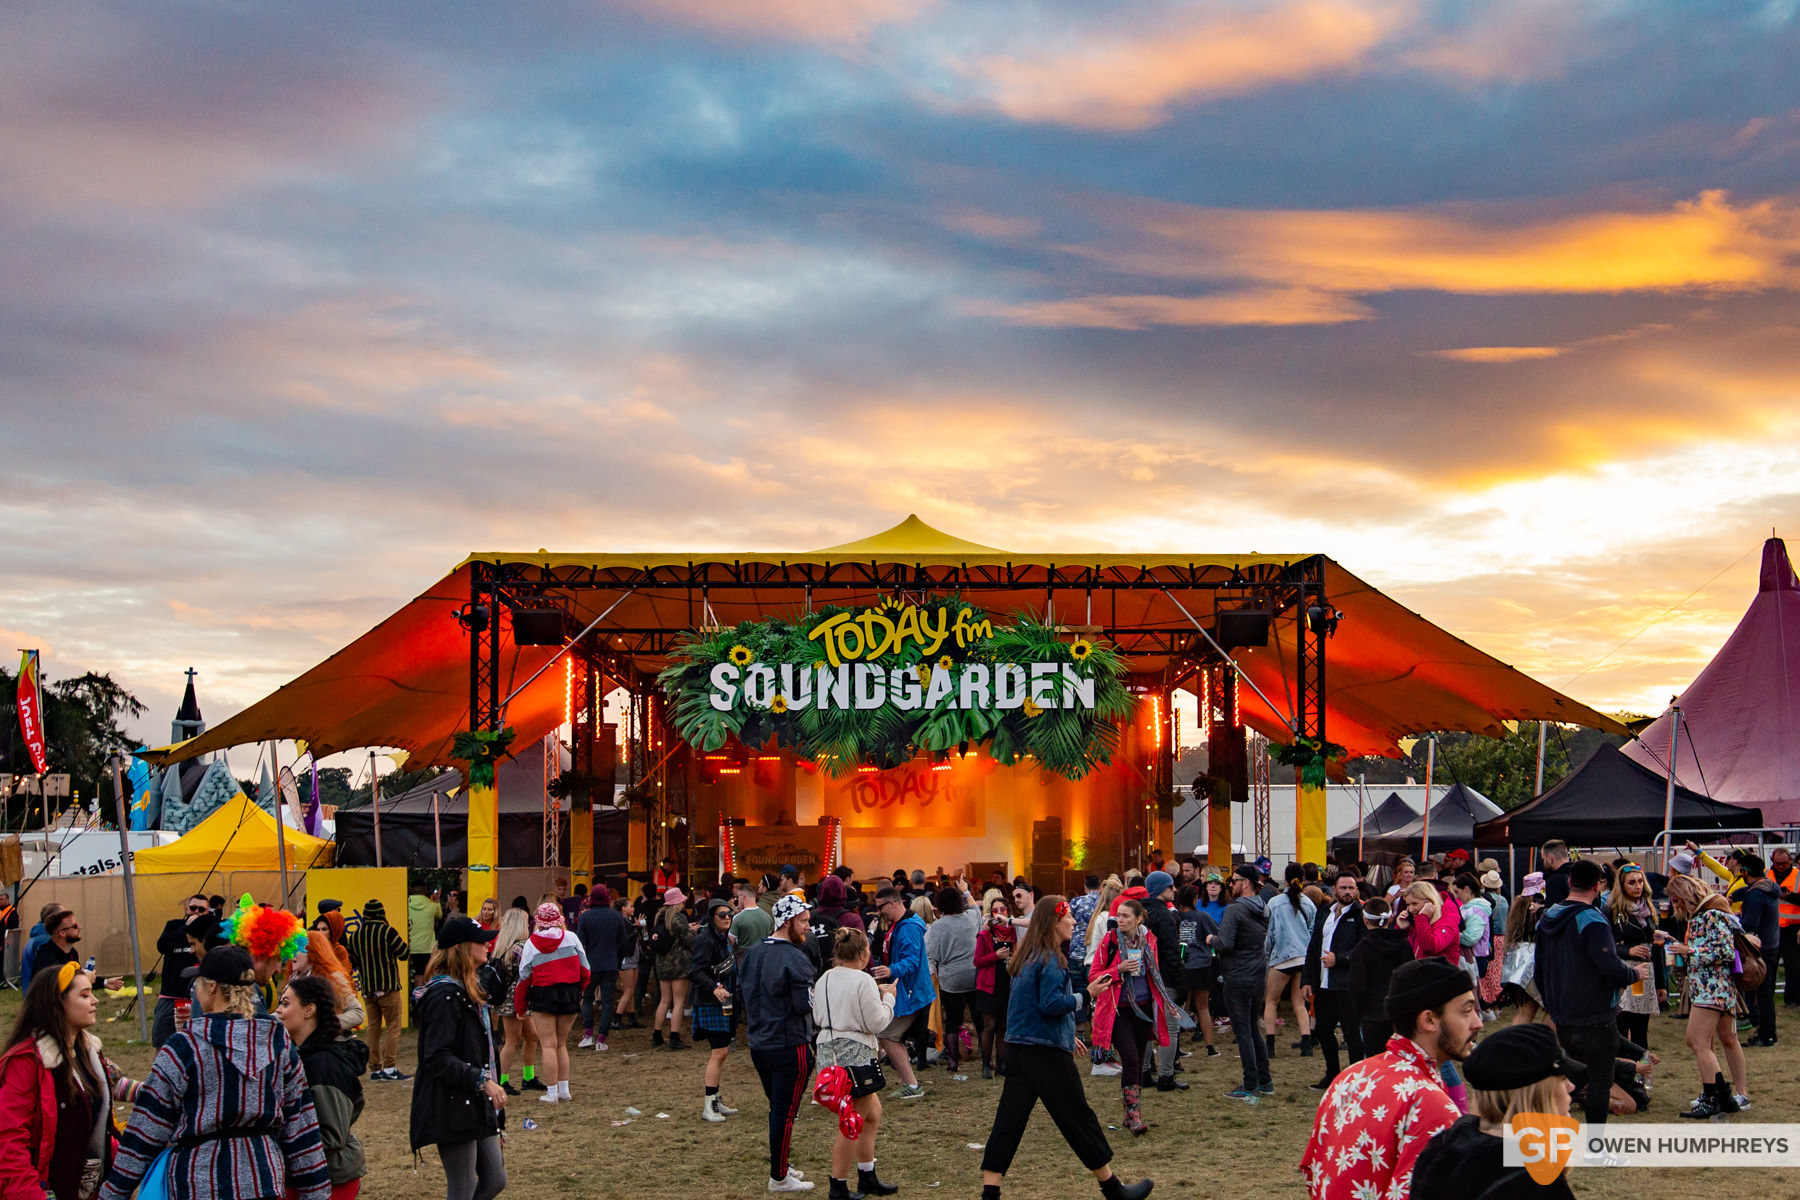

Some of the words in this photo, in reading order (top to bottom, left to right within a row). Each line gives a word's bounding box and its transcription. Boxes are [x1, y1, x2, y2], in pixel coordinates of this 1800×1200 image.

[809, 603, 949, 668] TODAY
[951, 607, 994, 649] fm
[709, 662, 1096, 712] SOUNDGARDEN
[840, 771, 940, 814] TODAY
[70, 850, 135, 876] tals.ie
